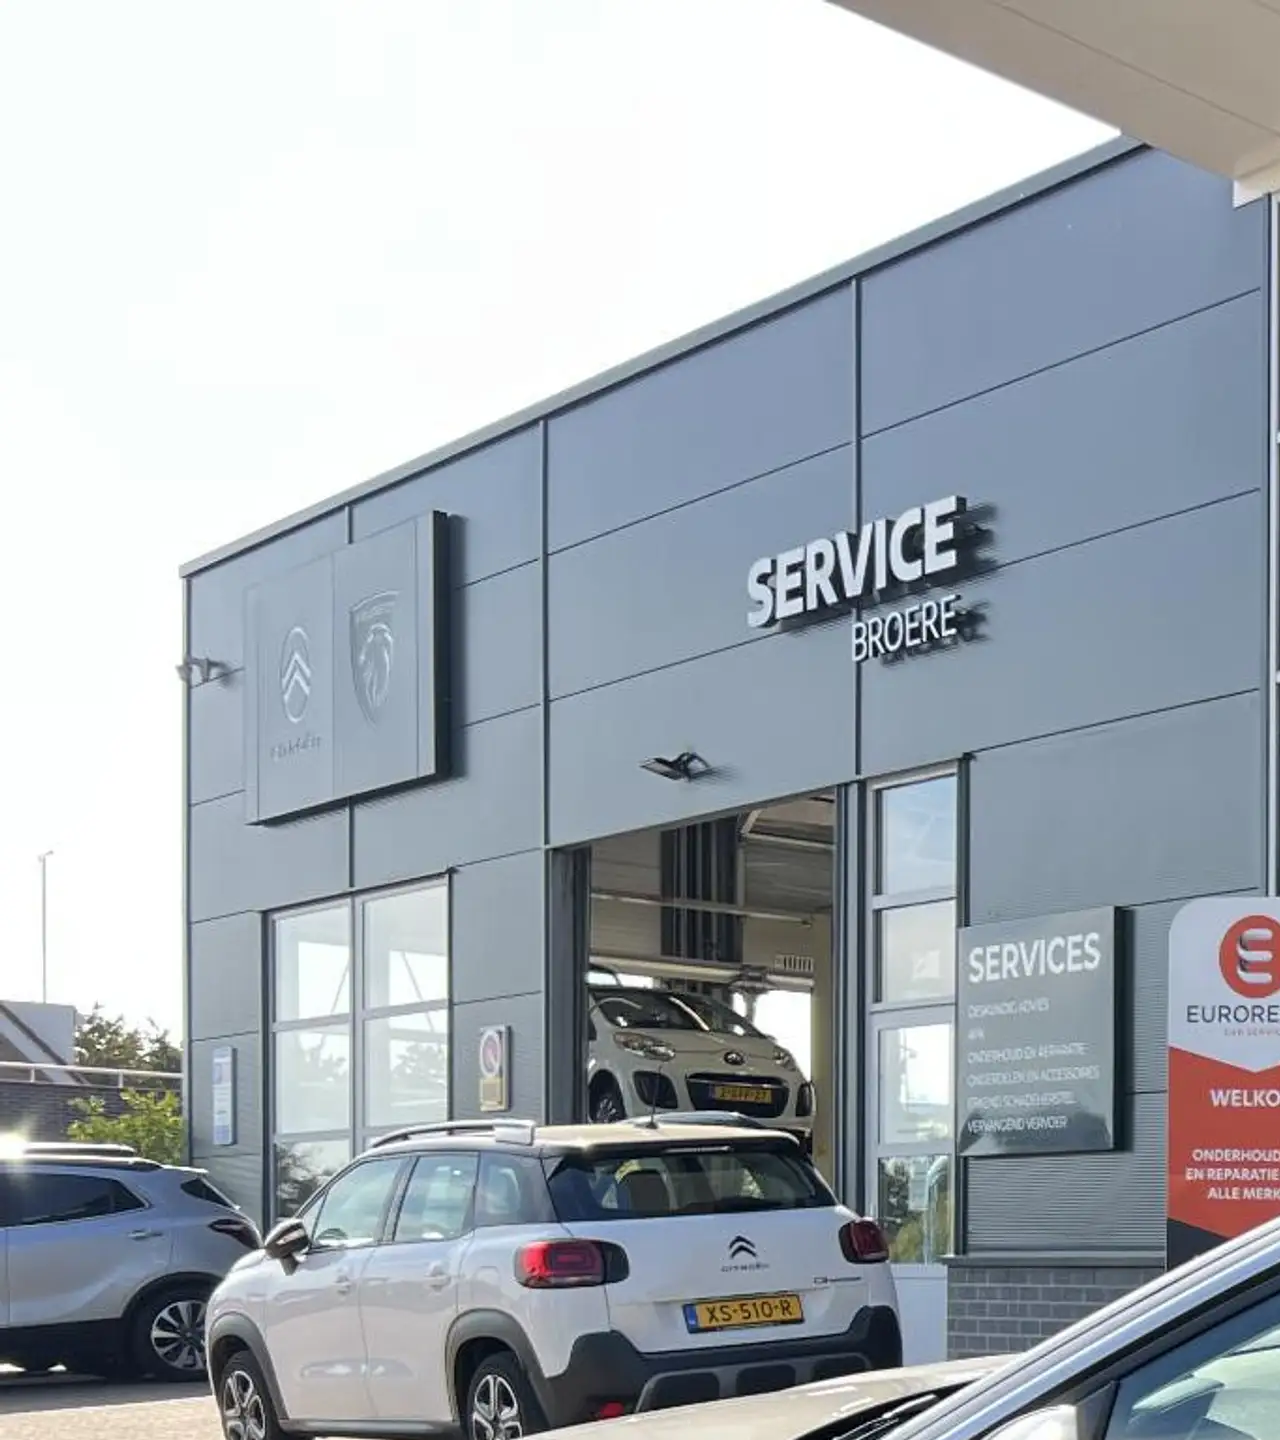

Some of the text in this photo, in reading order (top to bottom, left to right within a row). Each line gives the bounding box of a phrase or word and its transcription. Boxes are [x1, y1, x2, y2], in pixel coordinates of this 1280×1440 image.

[747, 494, 960, 629] SERVICE
[851, 594, 958, 664] BROERE
[967, 932, 1102, 985] SERVICES
[1185, 1167, 1204, 1181] EN
[1207, 1167, 1280, 1182] REPARATIE
[1207, 1186, 1241, 1201] ALLE
[705, 1299, 793, 1326] XS-510-R
